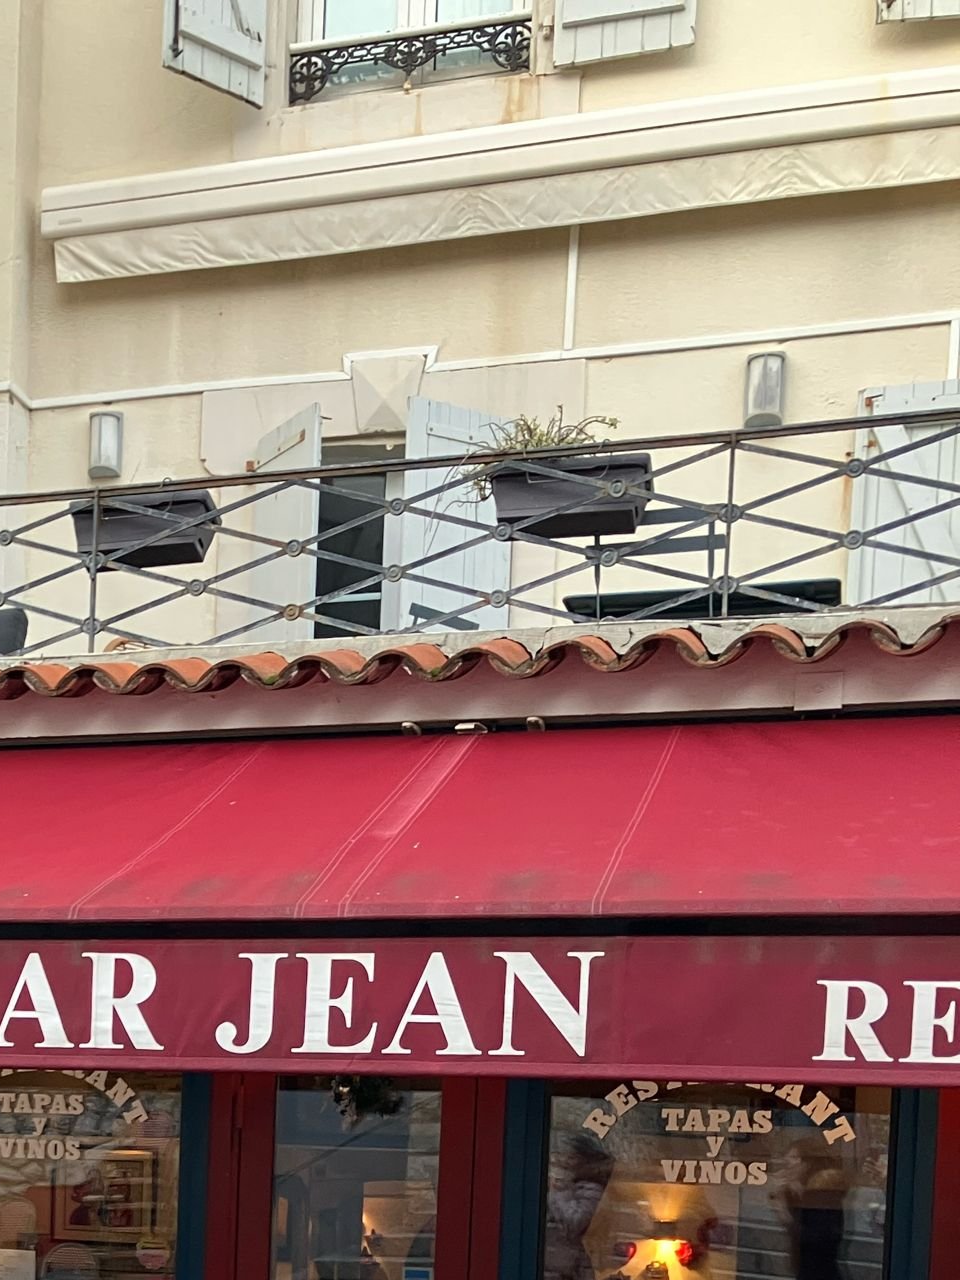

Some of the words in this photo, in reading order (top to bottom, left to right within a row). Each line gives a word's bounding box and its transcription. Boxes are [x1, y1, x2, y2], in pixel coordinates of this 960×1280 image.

[216, 951, 606, 1057] JEAN
[661, 1108, 773, 1134] TAPAS
[660, 1160, 768, 1185] VINOS
